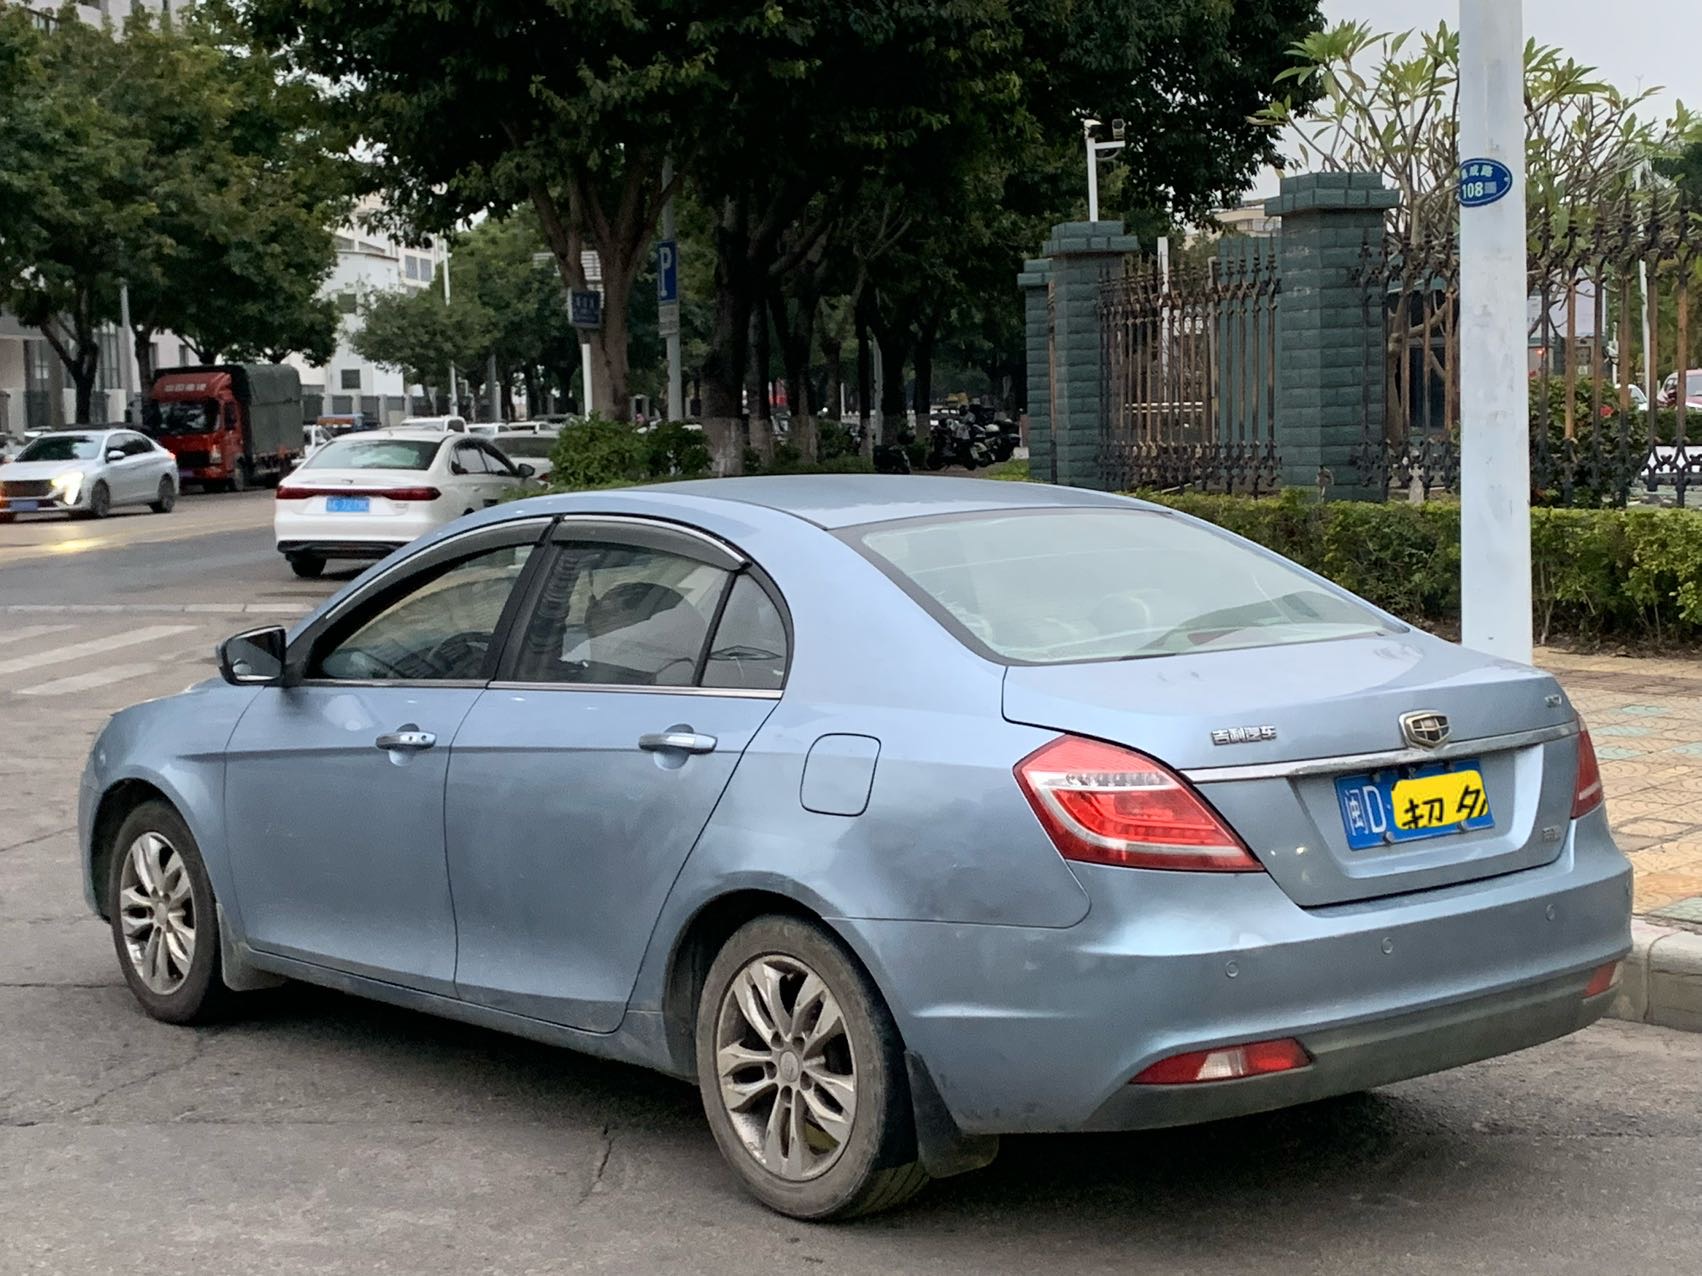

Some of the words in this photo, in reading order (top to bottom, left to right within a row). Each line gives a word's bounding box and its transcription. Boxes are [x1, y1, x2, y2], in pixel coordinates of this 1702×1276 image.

[1461, 181, 1484, 199] 108
[1211, 725, 1277, 746] 吉利汽车
